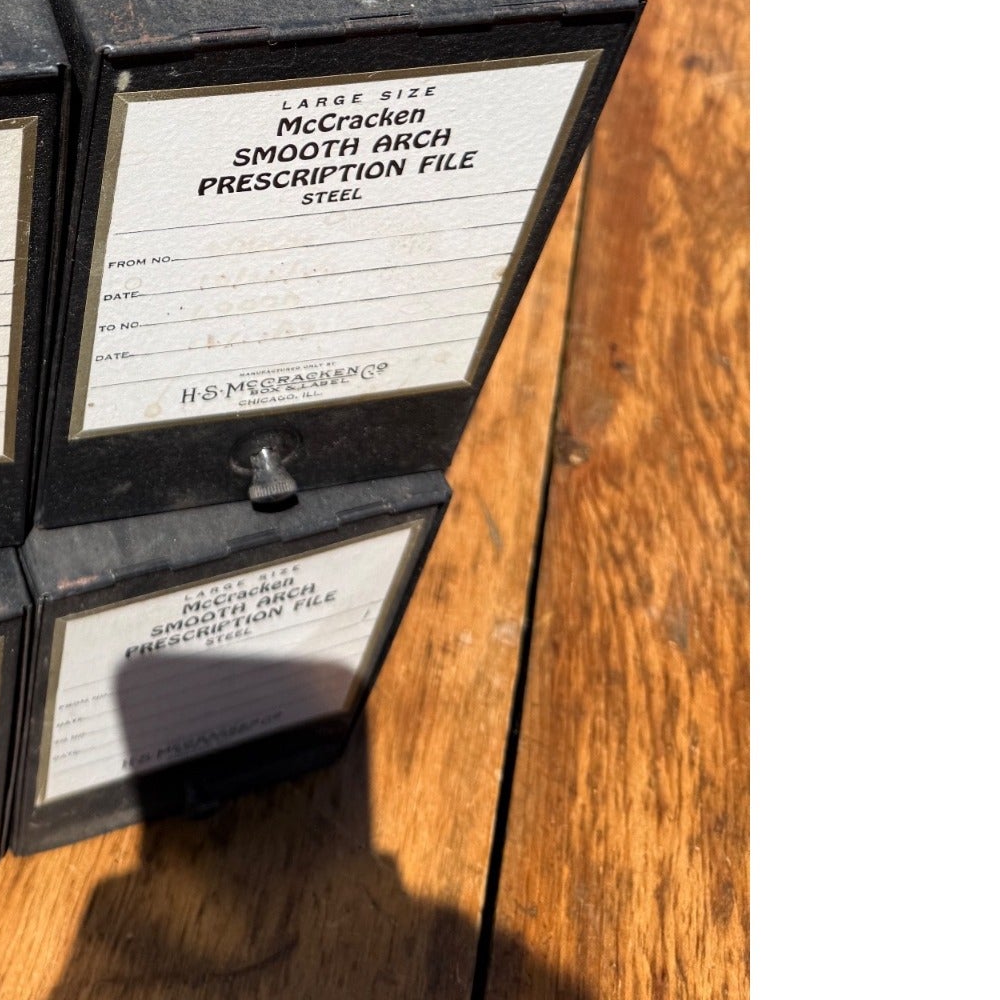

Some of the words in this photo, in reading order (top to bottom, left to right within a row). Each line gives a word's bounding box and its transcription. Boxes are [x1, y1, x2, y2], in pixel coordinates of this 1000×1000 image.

[281, 93, 363, 111] LARGE
[379, 86, 437, 101] SIZE
[276, 107, 426, 137] McCracken
[232, 137, 360, 167] SMOOTH
[371, 127, 452, 153] ARCH
[197, 158, 406, 197] PRESCRIPTION
[417, 149, 480, 175] FILE
[301, 187, 363, 206] STEEL
[107, 258, 147, 269] FROM
[103, 290, 139, 302] DATE
[98, 324, 116, 333] TO
[95, 351, 130, 362] DATE
[184, 579, 246, 601] LARGE
[259, 564, 301, 581] SIZE
[149, 602, 246, 638] SMOOTH
[255, 582, 317, 609] ARCH
[181, 577, 295, 616] McCracken
[125, 606, 284, 658] PRESCRIPTION
[292, 589, 339, 612] FILE
[204, 626, 253, 648] STEEL
